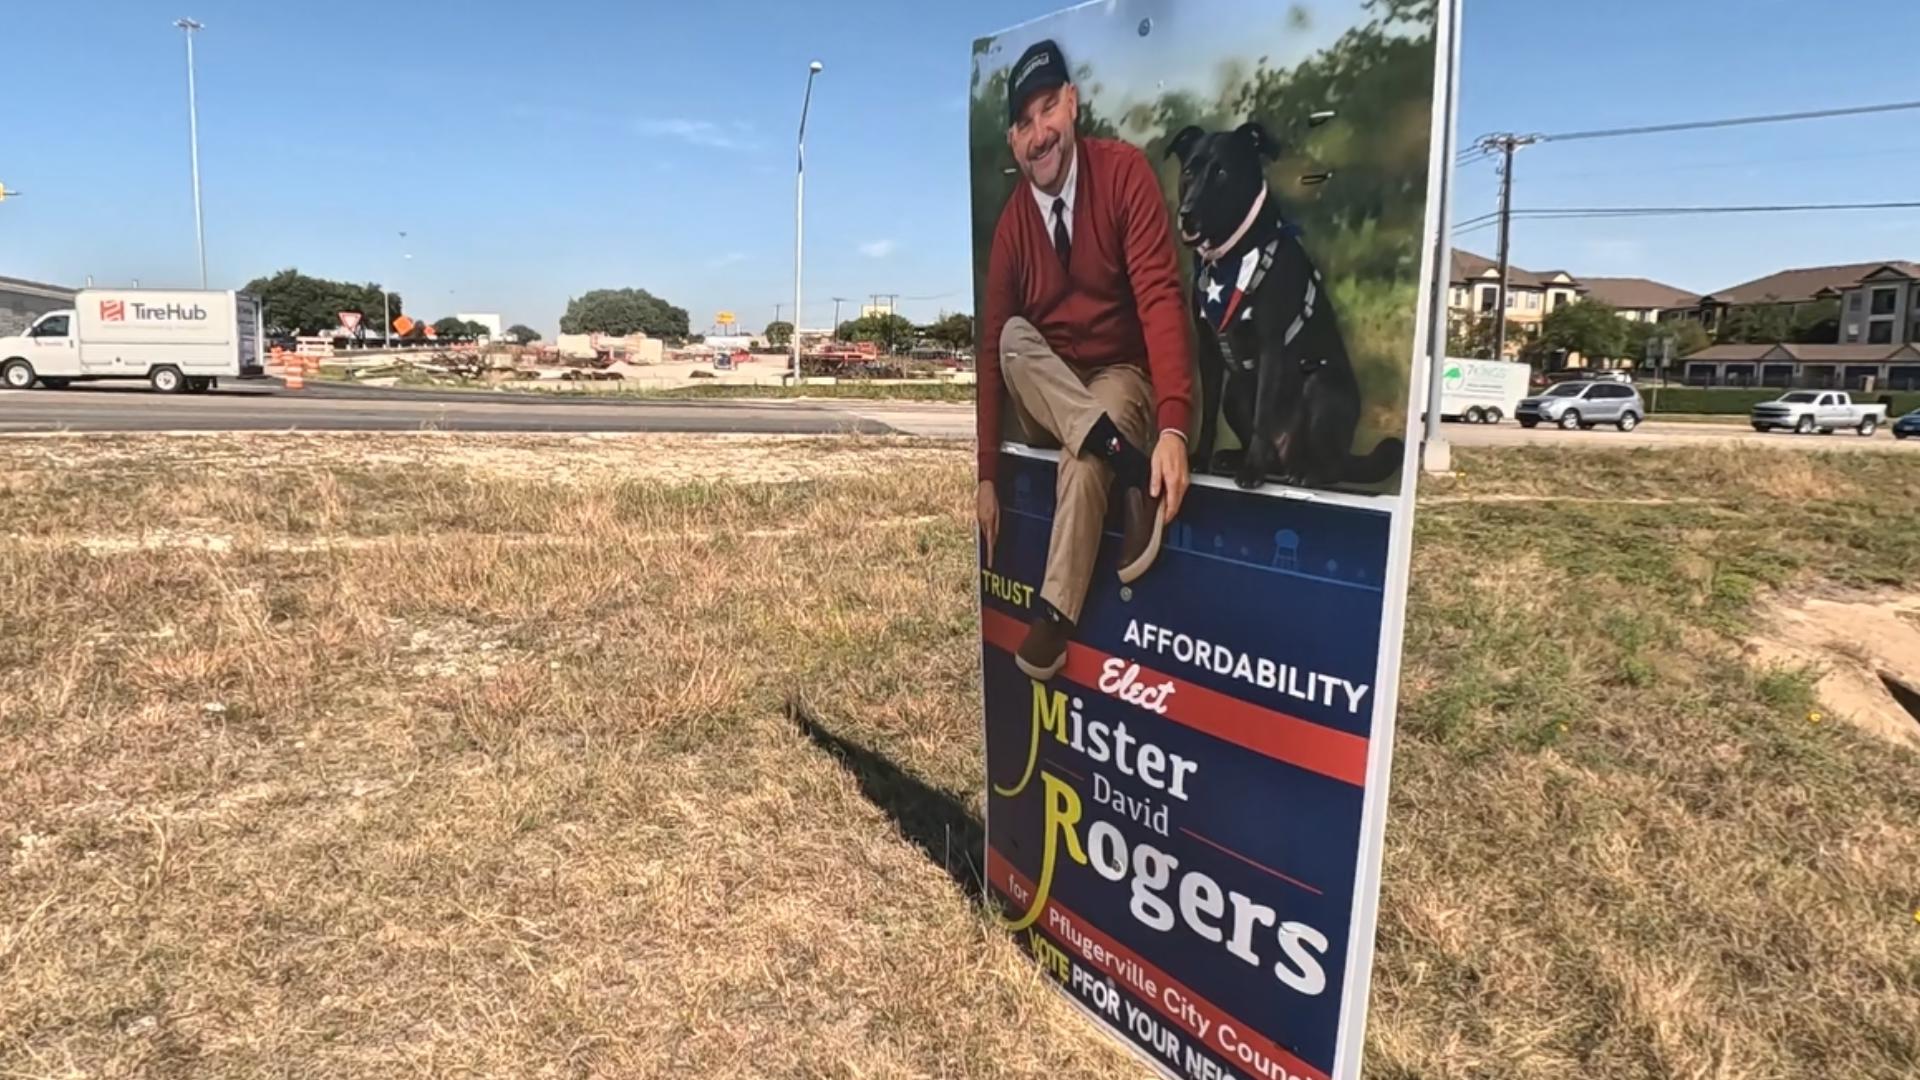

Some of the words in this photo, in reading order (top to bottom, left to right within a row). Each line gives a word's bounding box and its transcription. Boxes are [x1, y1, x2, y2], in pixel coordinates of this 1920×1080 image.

[130, 302, 207, 321] TireHub
[982, 569, 1035, 608] TRUST
[1098, 657, 1176, 714] Elect
[1123, 618, 1369, 714] AFFORDABILITY
[994, 679, 1198, 802] Mister
[1093, 772, 1169, 837] David
[1003, 770, 1329, 996] Rogers
[1008, 873, 1030, 904] for
[1050, 906, 1158, 999] Pflugerville
[1163, 987, 1211, 1039] City
[1218, 1024, 1314, 1080] Coun
[1028, 927, 1069, 982] VOTE
[1072, 963, 1120, 1021] PFOR
[1125, 999, 1181, 1066] YOUR
